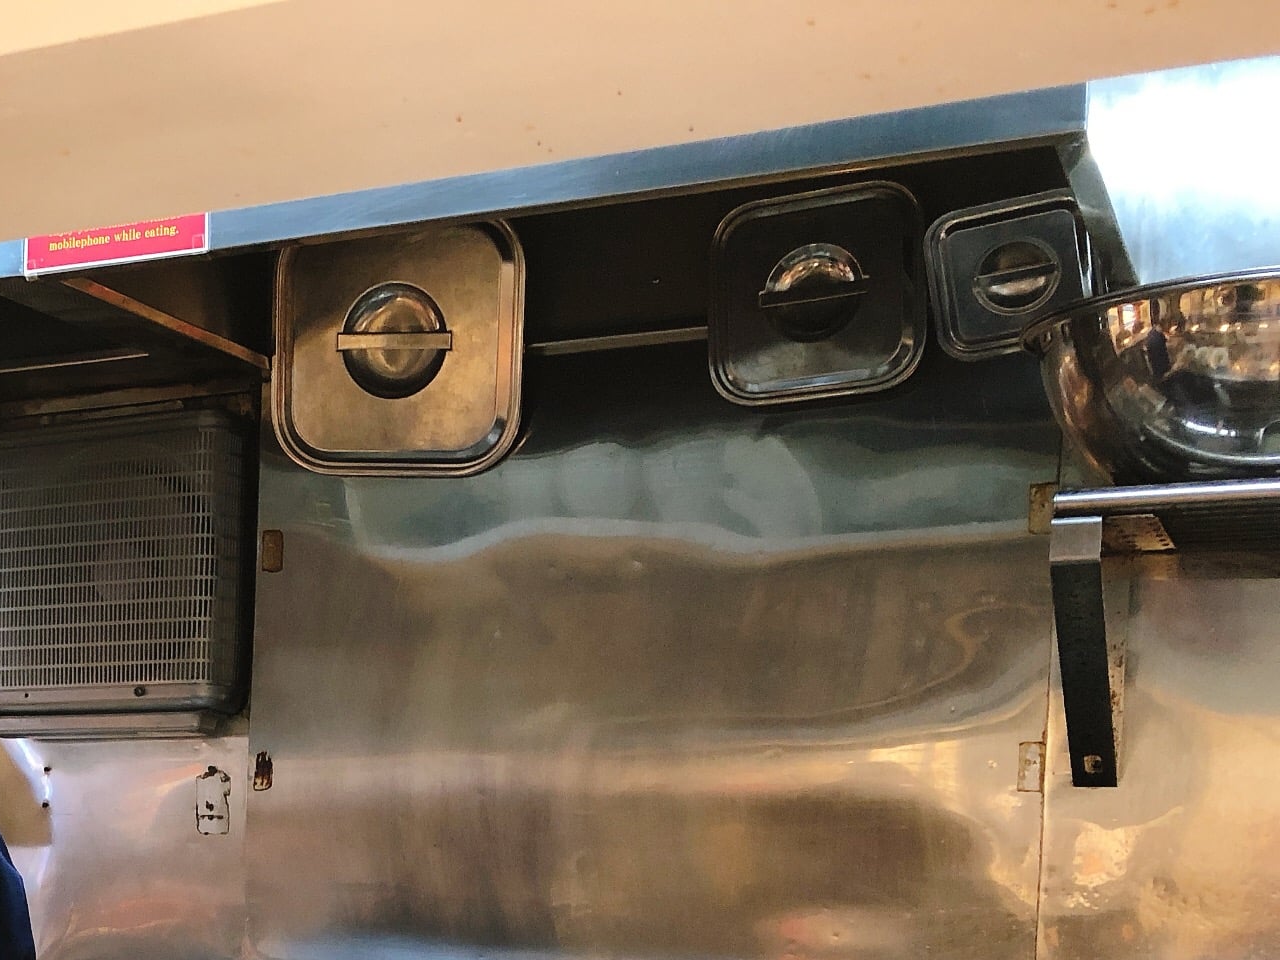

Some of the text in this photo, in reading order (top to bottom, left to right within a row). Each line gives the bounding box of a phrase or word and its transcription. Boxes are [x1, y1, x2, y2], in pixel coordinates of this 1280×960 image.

[49, 235, 111, 251] mobilephone
[114, 228, 141, 242] while
[144, 224, 179, 238] eating.
